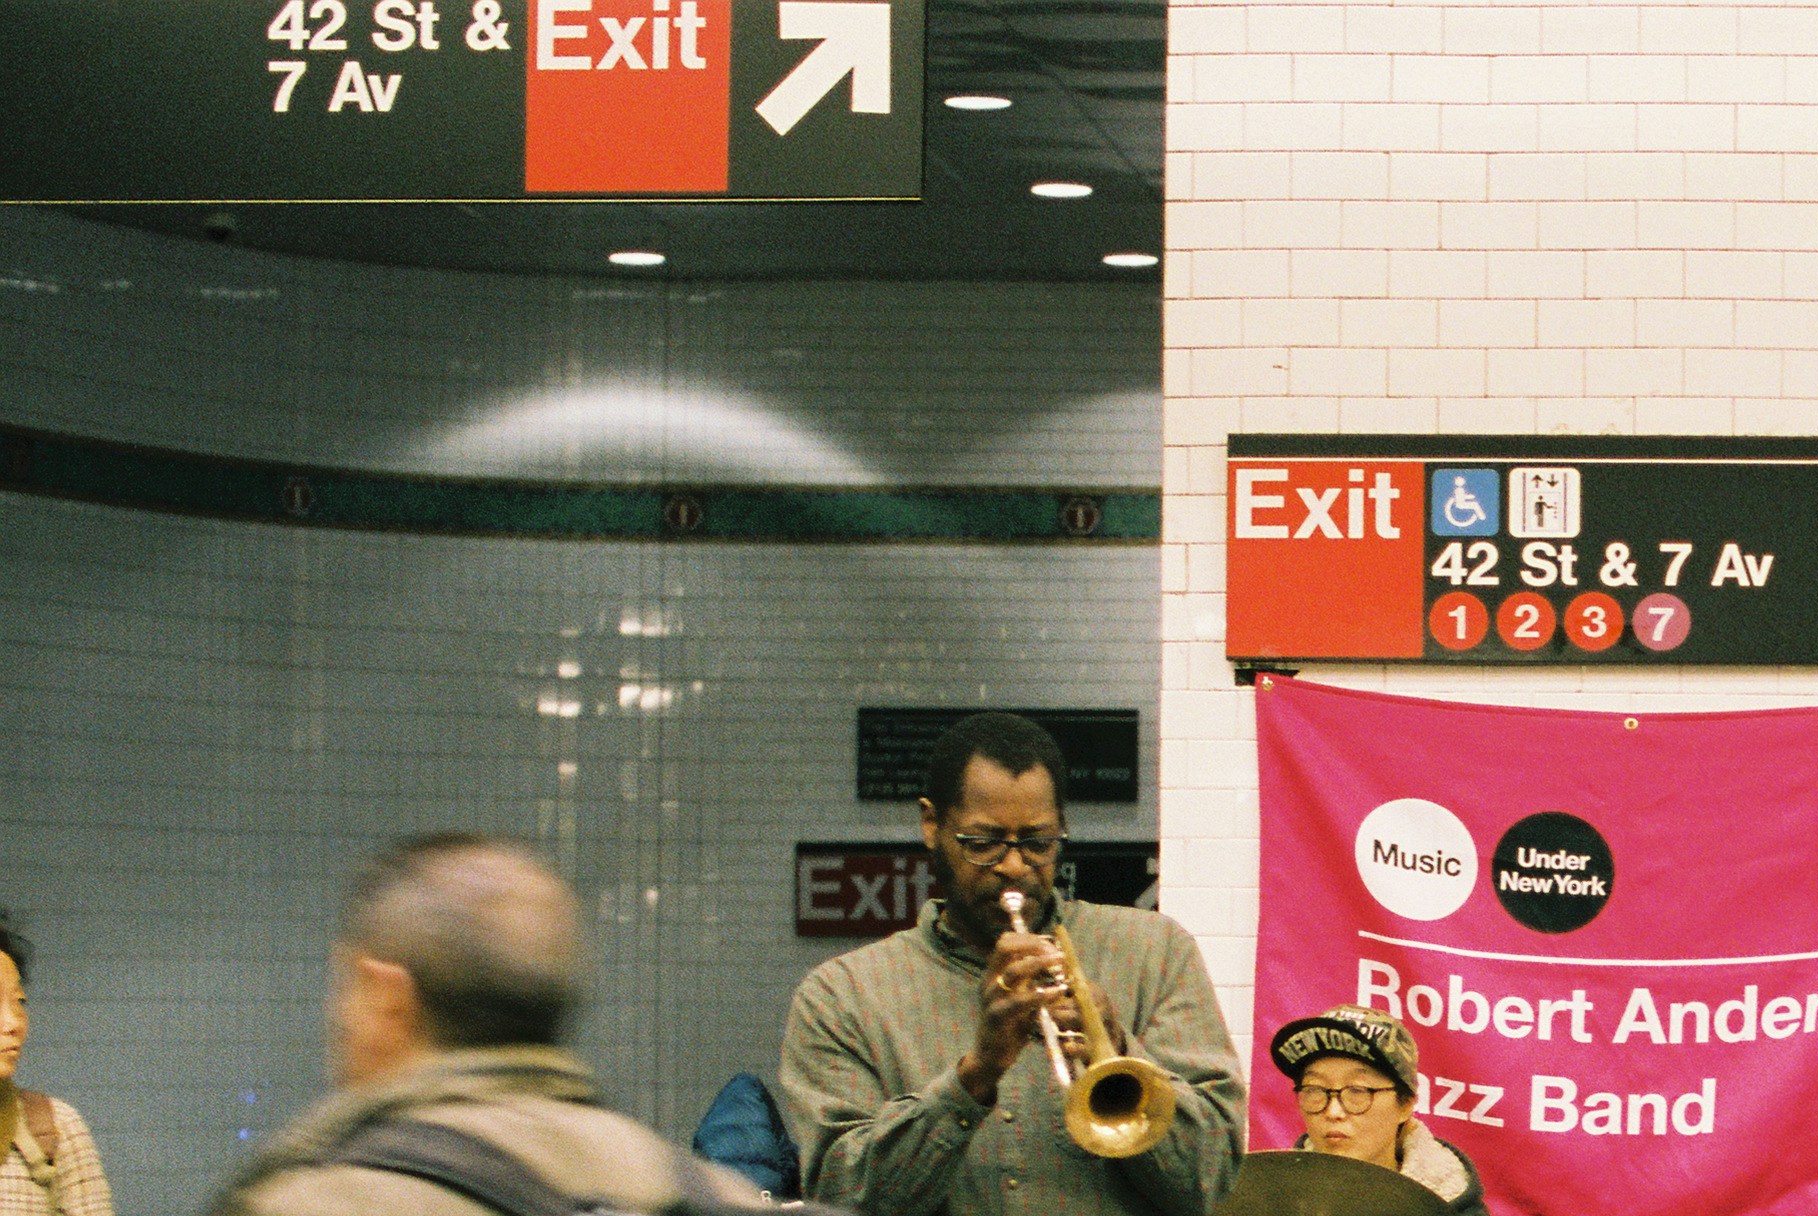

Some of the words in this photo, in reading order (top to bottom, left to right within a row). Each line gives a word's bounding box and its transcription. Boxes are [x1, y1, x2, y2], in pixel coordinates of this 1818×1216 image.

[267, 0, 348, 51] 42
[371, 0, 440, 51] St
[465, 0, 511, 51] &
[536, 0, 707, 70] Exit
[268, 61, 307, 112] 7
[328, 61, 402, 112] Av
[1234, 468, 1400, 540] Exit
[1431, 543, 1500, 586] 42
[1520, 543, 1578, 587] St
[1599, 543, 1638, 588] &
[1659, 544, 1693, 587] 7
[1712, 544, 1774, 588] Av
[1450, 607, 1467, 637] 1
[1513, 607, 1541, 638] 2
[1581, 607, 1608, 638] 3
[1648, 608, 1676, 639] 7
[1373, 838, 1462, 877] Music
[1517, 847, 1590, 872] Under
[799, 856, 937, 920] Exit
[1500, 870, 1550, 895] New
[1553, 874, 1606, 898] York
[1356, 958, 1593, 1044] Robert
[1411, 1072, 1504, 1128] zz
[1530, 1074, 1717, 1135] Band
